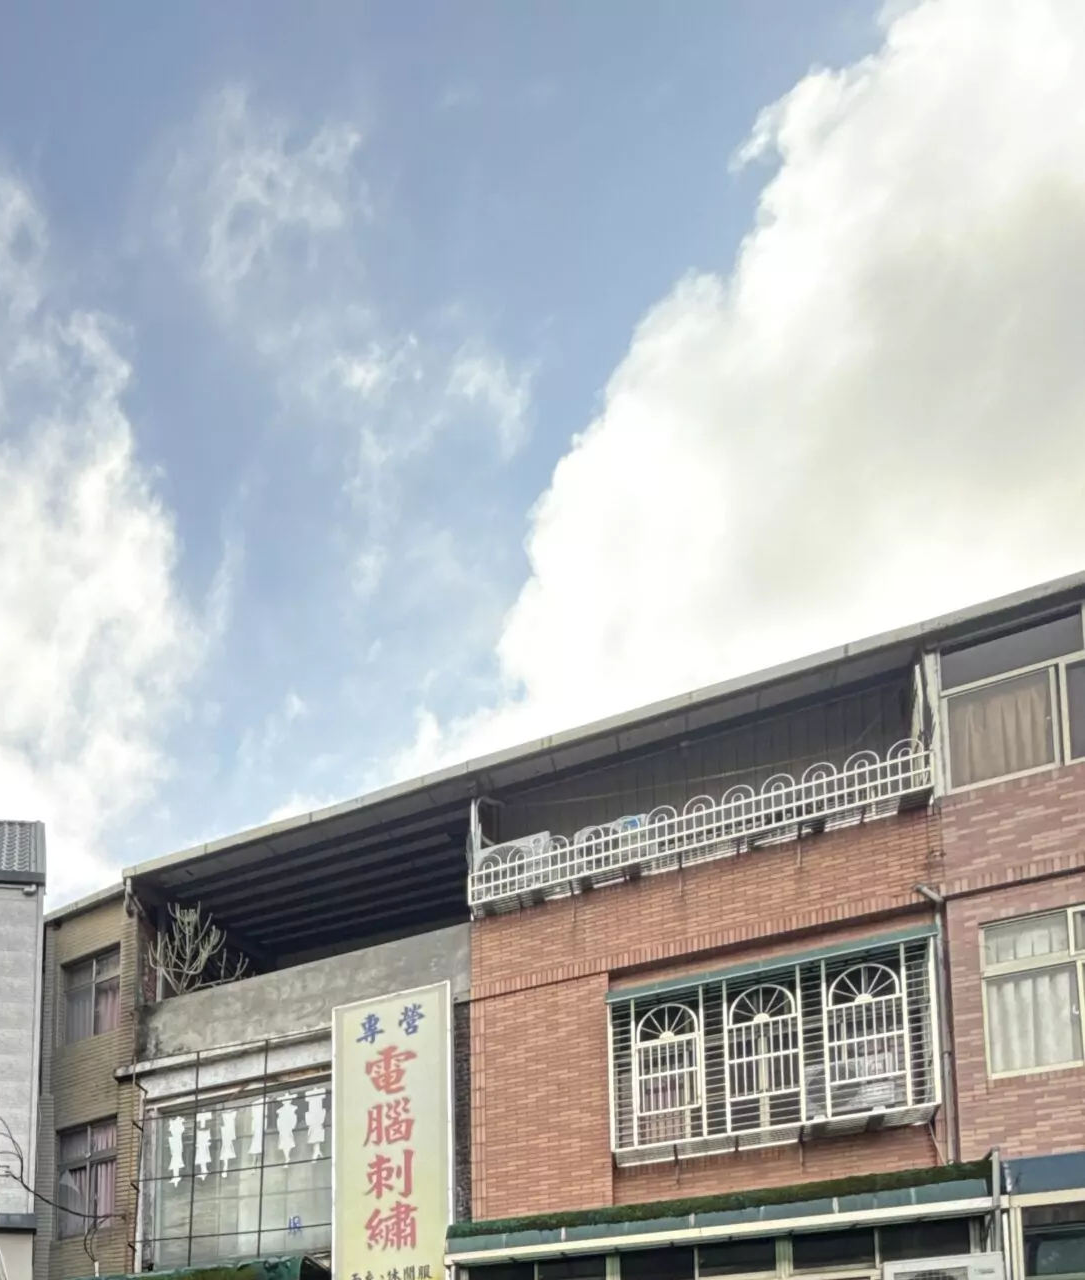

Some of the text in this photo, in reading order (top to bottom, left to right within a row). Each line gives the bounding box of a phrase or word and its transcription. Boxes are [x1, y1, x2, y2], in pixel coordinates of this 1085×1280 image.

[356, 1003, 425, 1044] 專營
[362, 1046, 417, 1252] 電腦刺繡
